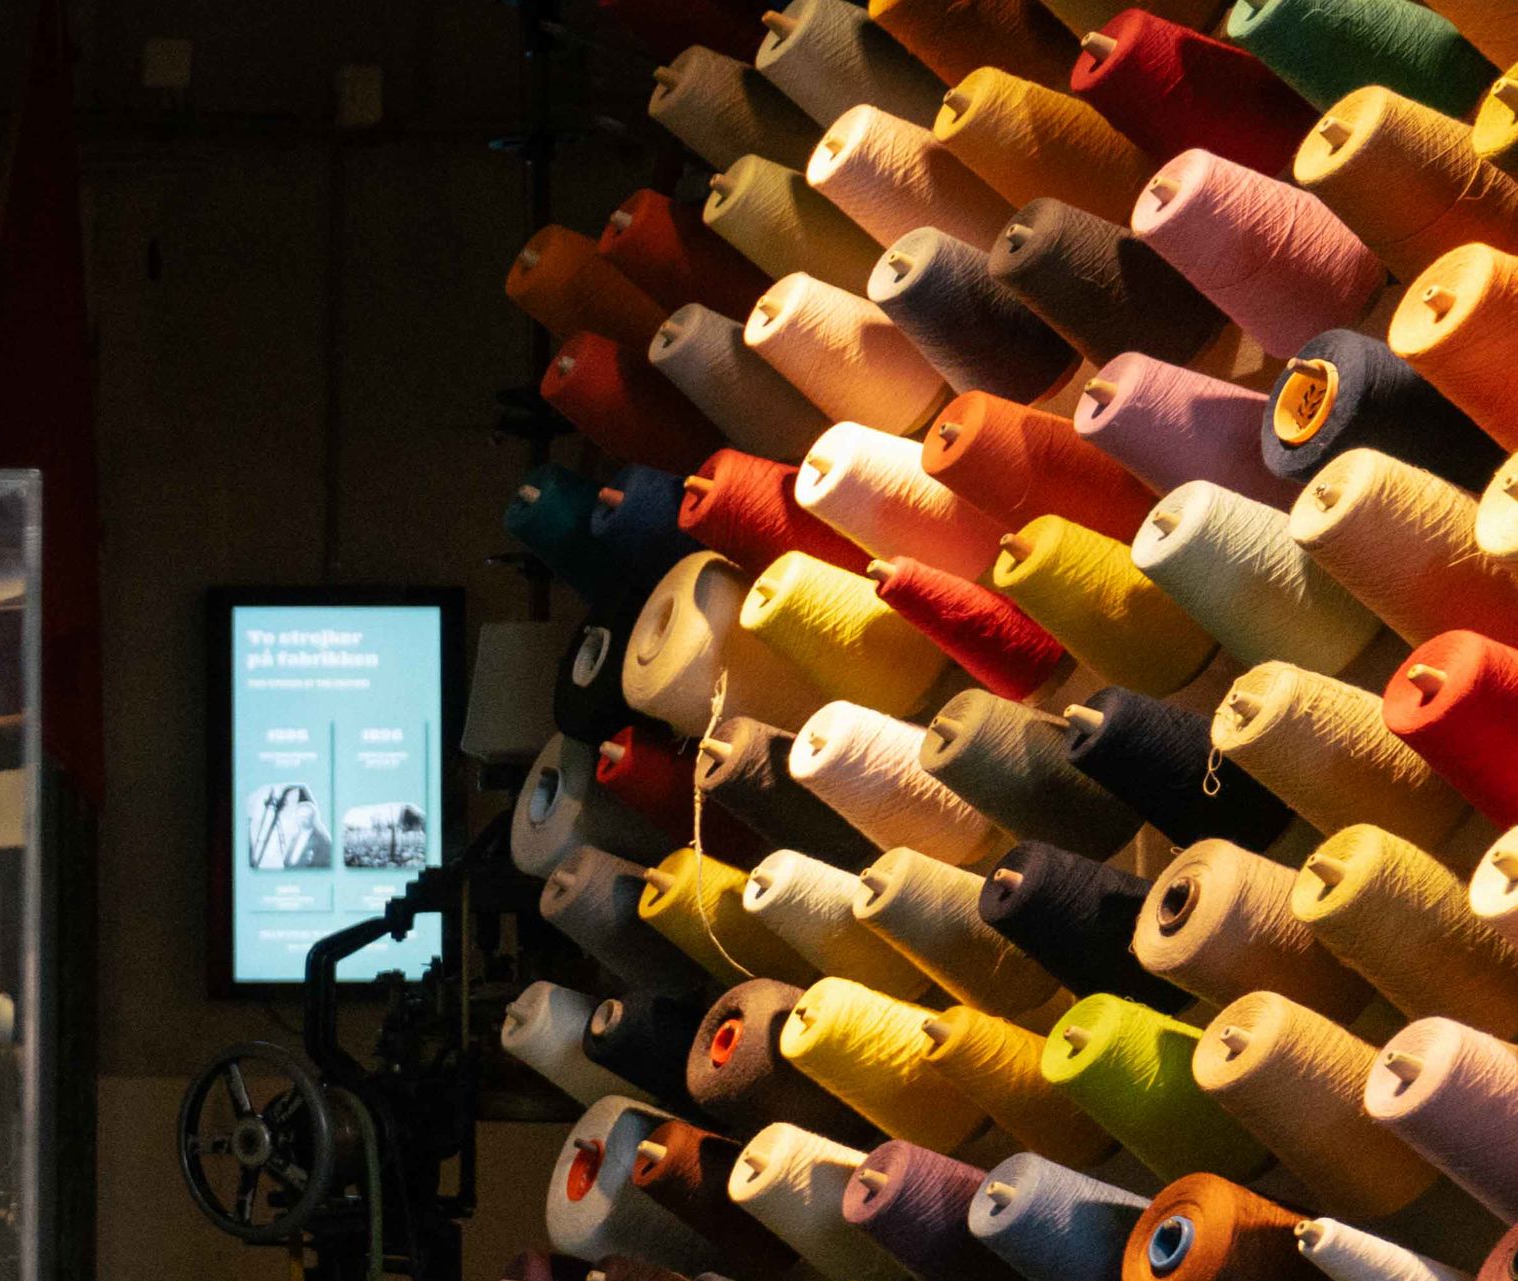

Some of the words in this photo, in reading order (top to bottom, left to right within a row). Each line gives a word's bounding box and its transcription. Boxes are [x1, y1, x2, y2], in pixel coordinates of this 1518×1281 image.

[247, 628, 275, 647] To
[279, 628, 362, 650] strejker
[246, 649, 274, 671] på
[276, 649, 379, 669] fabrikken
